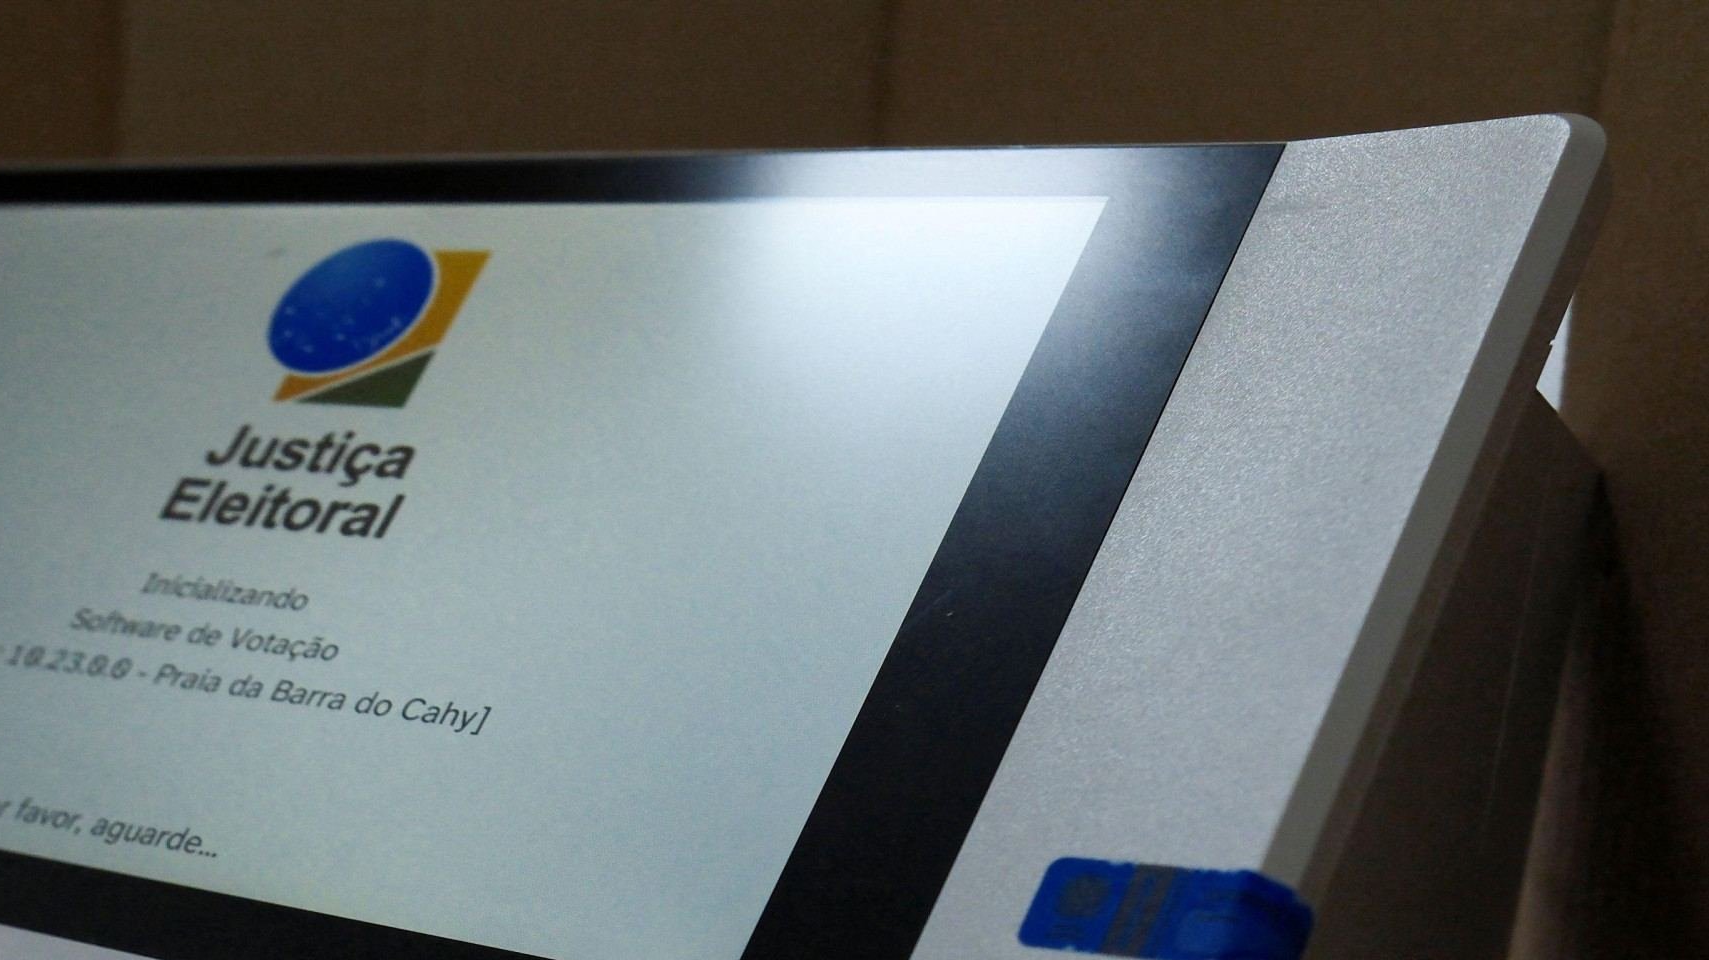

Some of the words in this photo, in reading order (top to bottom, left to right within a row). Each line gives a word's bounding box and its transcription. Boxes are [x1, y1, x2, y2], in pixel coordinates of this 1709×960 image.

[205, 422, 414, 487] Justiça
[160, 477, 405, 540] Eleitoral
[141, 572, 309, 612] Inicializando
[70, 606, 182, 642] Software
[187, 622, 222, 648] de
[230, 626, 339, 662] Votação
[153, 662, 222, 694] Praia
[228, 675, 264, 700] da
[270, 678, 347, 711] Barra
[354, 691, 392, 717] do
[401, 697, 492, 736] Cahy]
[15, 797, 83, 836] favor,
[90, 816, 218, 858] aguarde...
